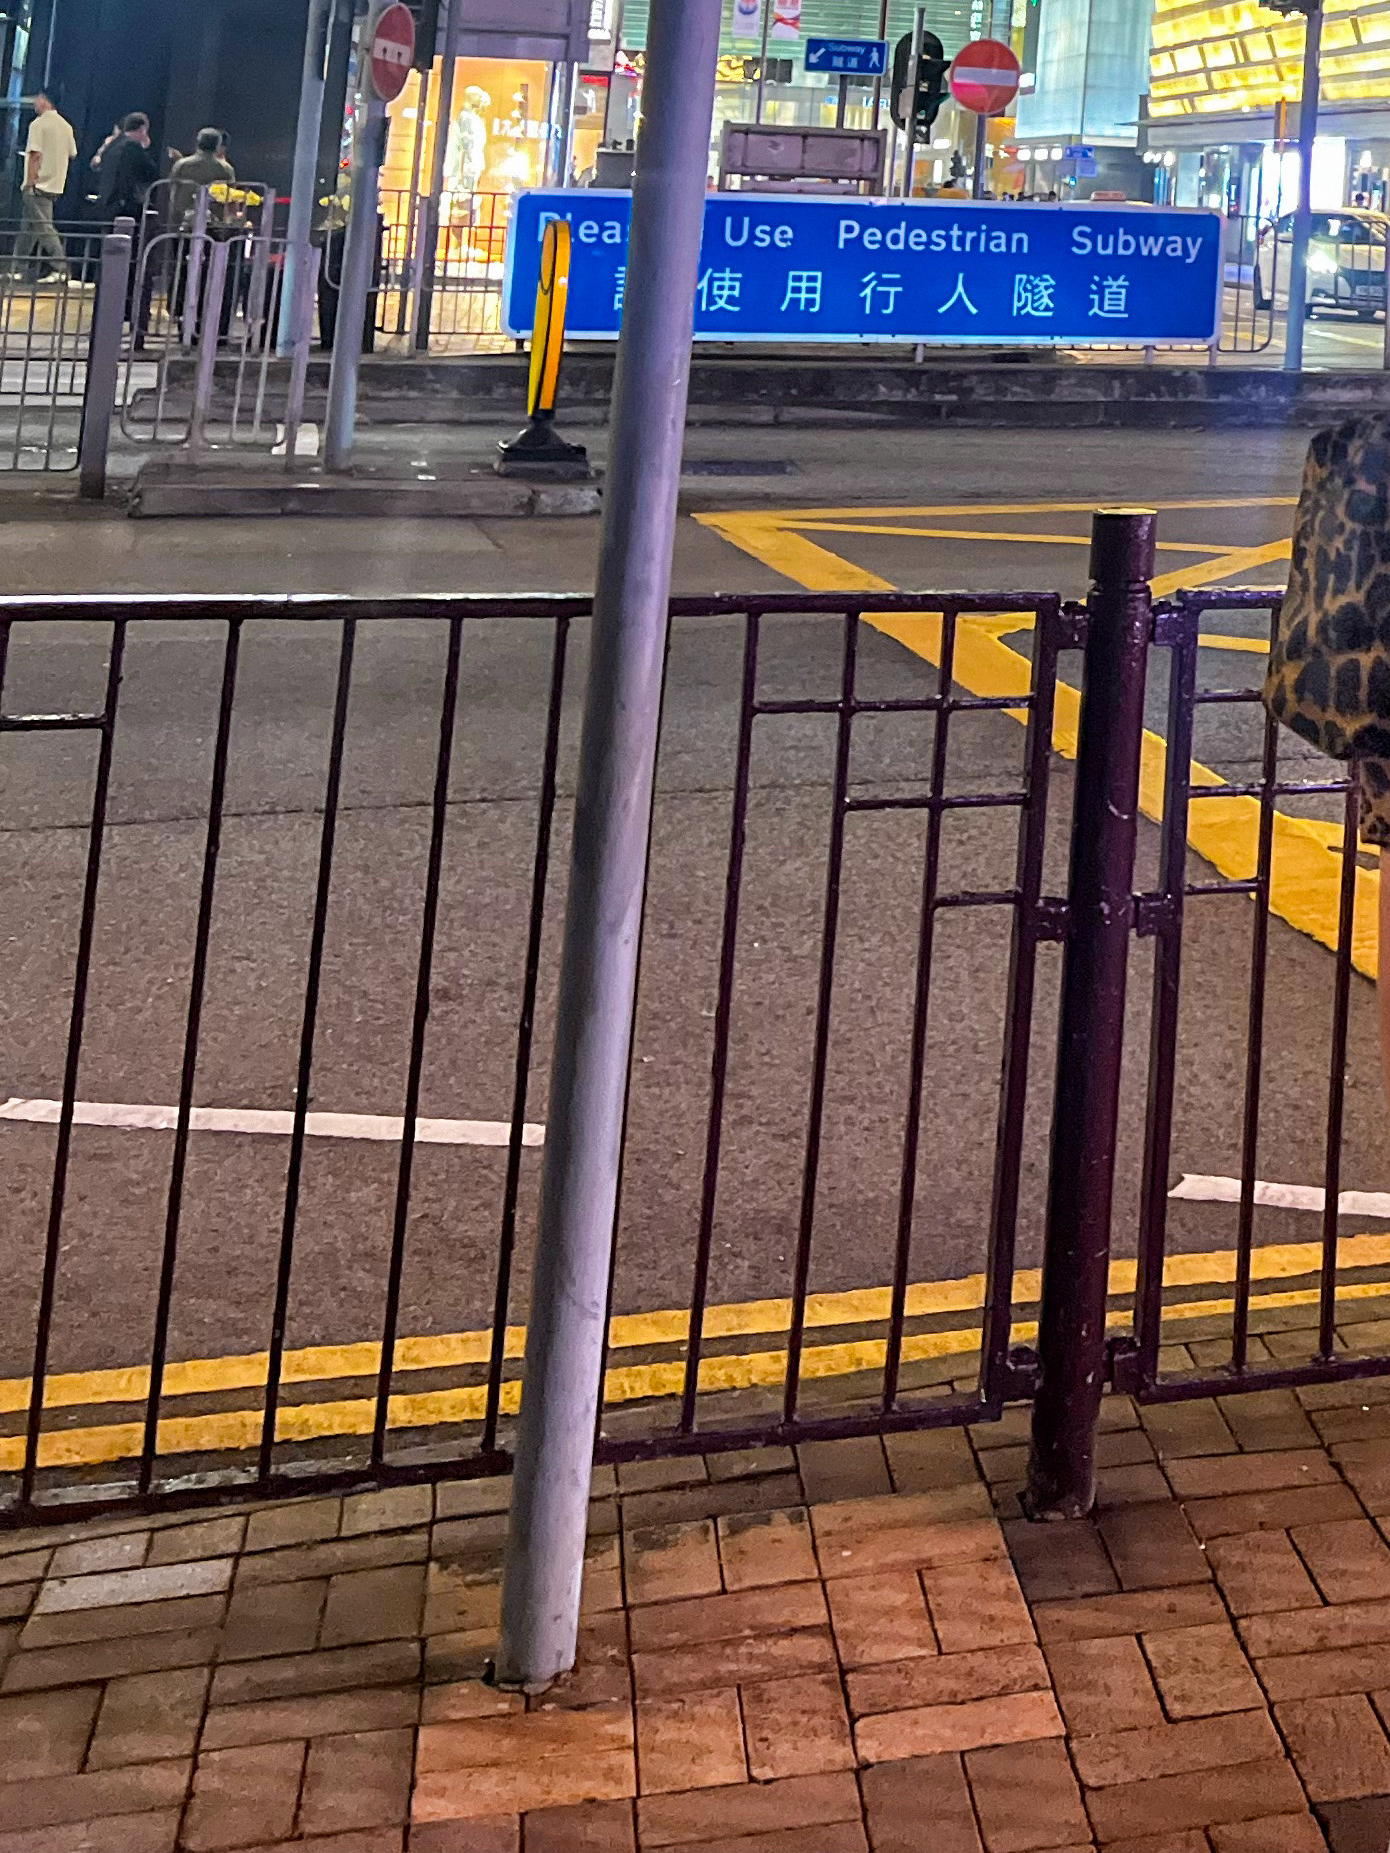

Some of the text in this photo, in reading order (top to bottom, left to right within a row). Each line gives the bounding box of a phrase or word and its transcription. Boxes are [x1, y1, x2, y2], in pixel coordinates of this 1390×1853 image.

[724, 216, 795, 248] Use
[837, 220, 1030, 255] Pedestrian
[1070, 224, 1204, 264] Subway
[612, 266, 1130, 319] 使用行人隧道
